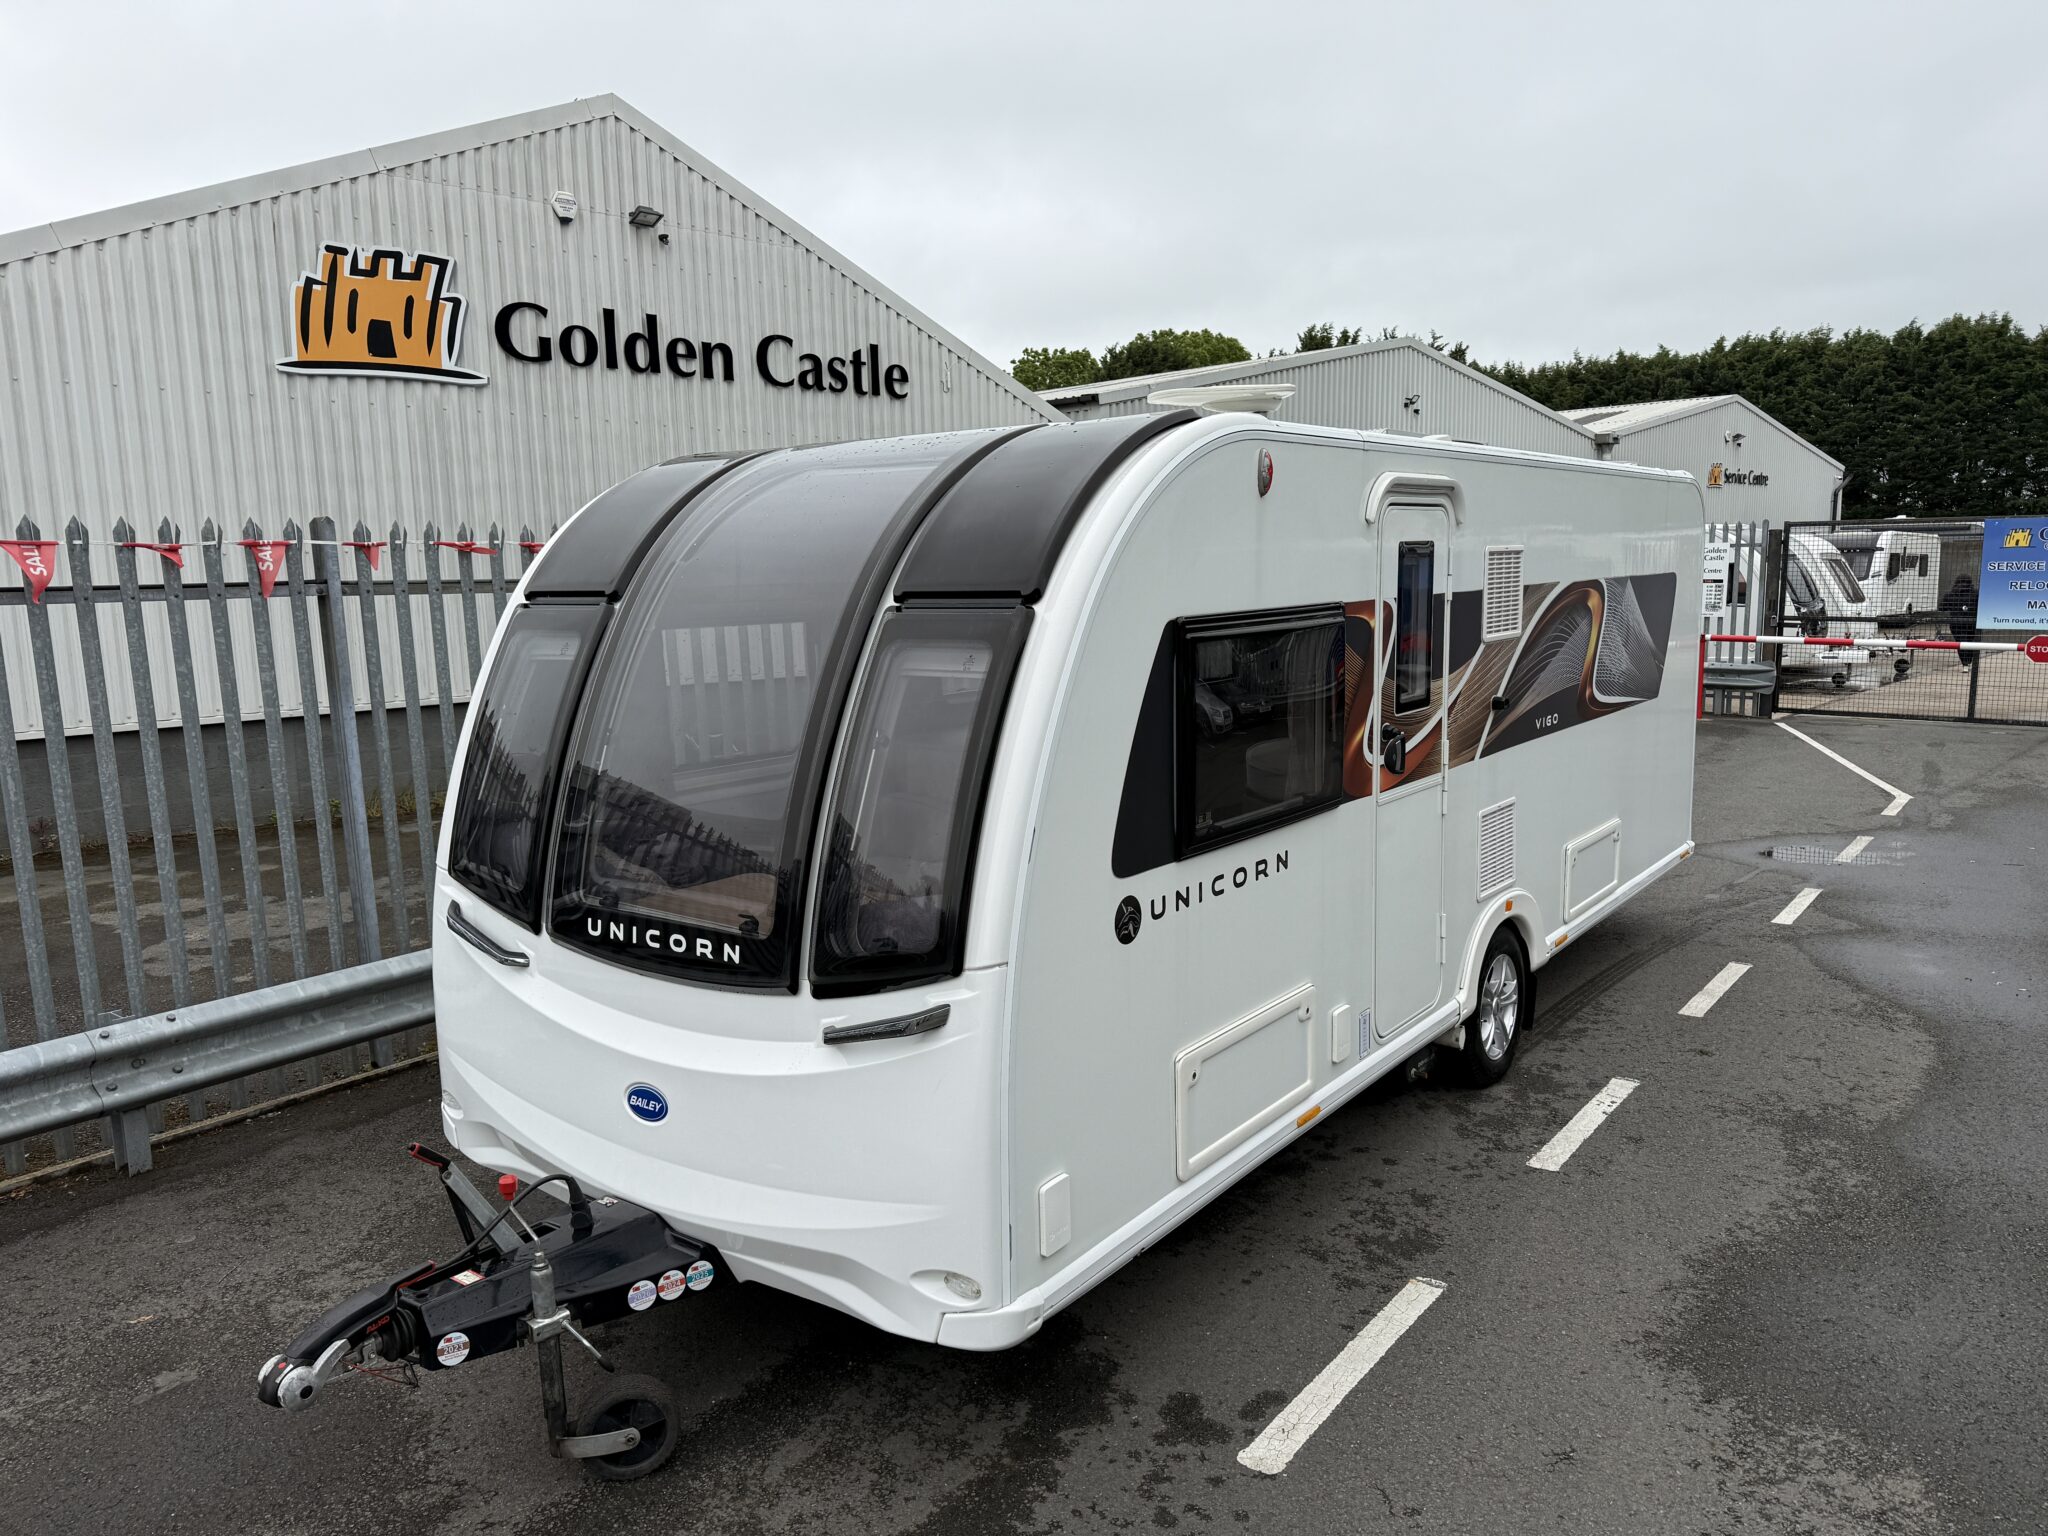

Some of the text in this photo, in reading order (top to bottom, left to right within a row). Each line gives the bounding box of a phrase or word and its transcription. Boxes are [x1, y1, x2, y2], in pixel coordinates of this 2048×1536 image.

[495, 301, 909, 400] Golden Castle
[1724, 467, 1769, 487] Service Centre
[1988, 561, 2046, 571] SERVICE
[2009, 580, 2048, 591] RELO
[2026, 600, 2048, 610] MA
[2011, 617, 2037, 625] round,
[1535, 713, 1559, 730] VIGO
[1150, 849, 1289, 921] UNICORN
[587, 917, 740, 965] UNICORN
[629, 1094, 663, 1113] BAILEY
[443, 1343, 465, 1355] 2023
